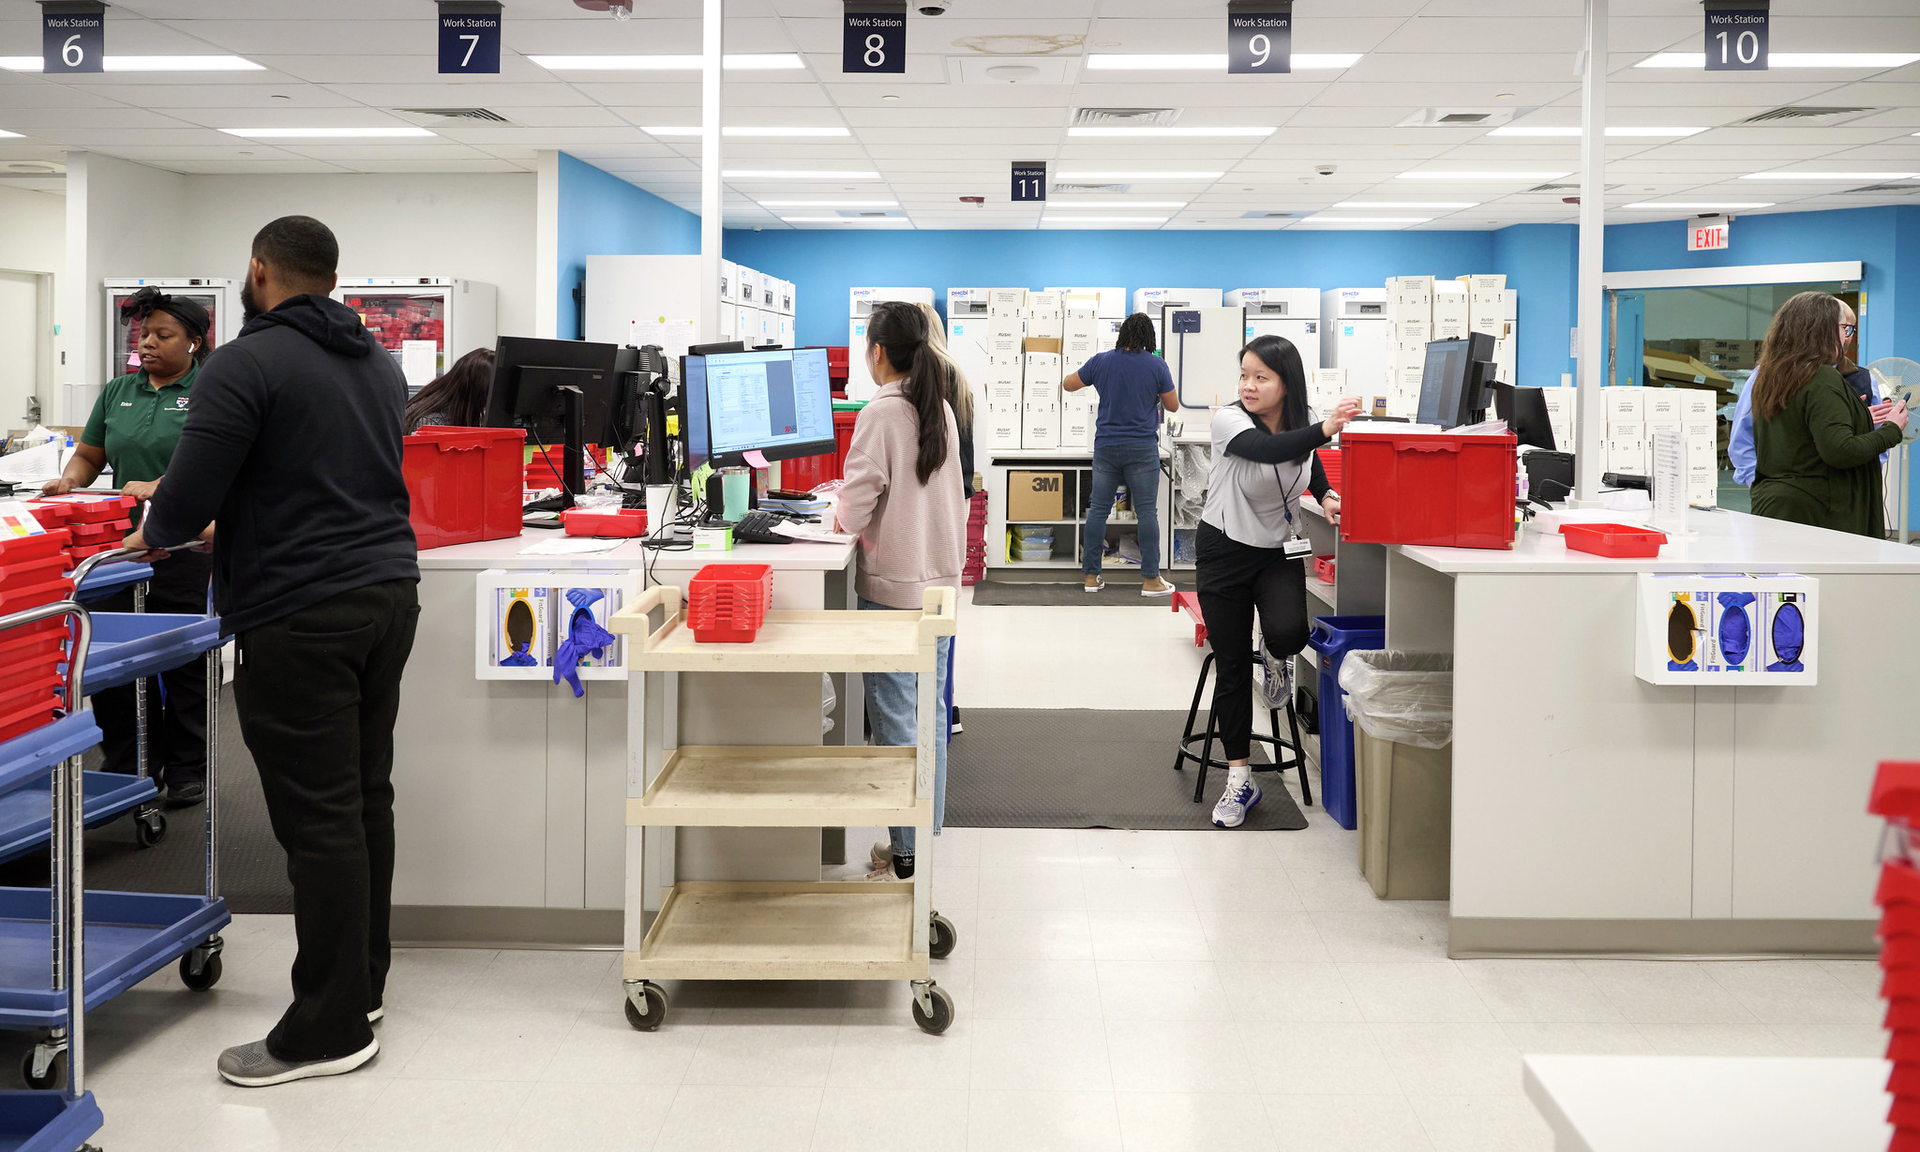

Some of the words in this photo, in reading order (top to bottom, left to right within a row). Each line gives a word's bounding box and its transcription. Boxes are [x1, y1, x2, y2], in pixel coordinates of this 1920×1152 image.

[47, 19, 69, 28] Work
[70, 18, 99, 28] Station
[443, 18, 465, 28] Work
[466, 18, 497, 28] Station
[848, 18, 871, 27] Work
[872, 18, 902, 27] Station
[1233, 18, 1256, 27] Work
[1257, 18, 1288, 27] Station
[1710, 15, 1733, 24] Work
[1734, 14, 1765, 24] Station
[62, 34, 84, 67] 6
[459, 34, 480, 67] 7
[863, 33, 885, 67] 8
[1249, 33, 1271, 67] 9
[1716, 30, 1759, 64] 10
[1018, 179, 1039, 198] 11
[1696, 228, 1722, 248] EXIT
[346, 297, 362, 307] LAB
[1032, 476, 1059, 492] 3M
